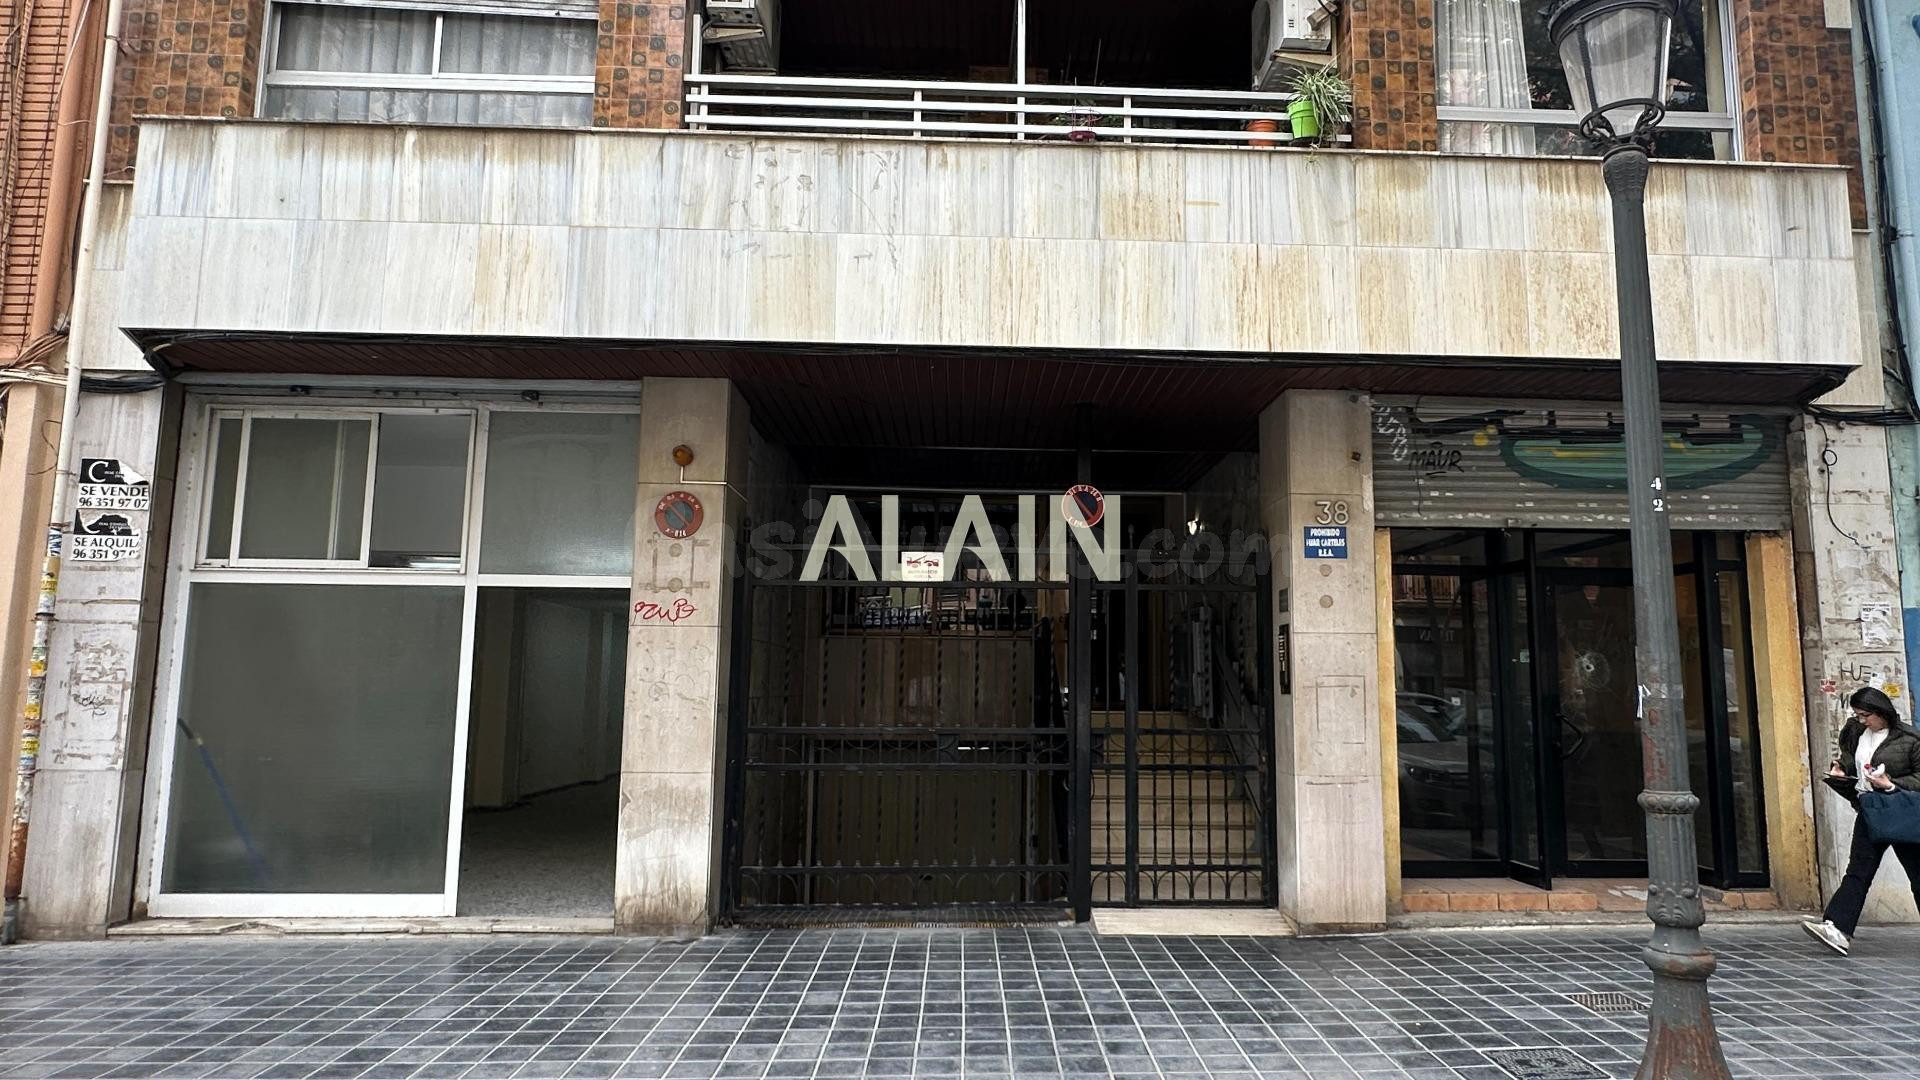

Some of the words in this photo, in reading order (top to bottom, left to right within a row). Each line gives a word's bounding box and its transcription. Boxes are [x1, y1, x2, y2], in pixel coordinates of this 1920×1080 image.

[80, 486, 97, 496] SE
[100, 486, 148, 497] VENDE
[79, 497, 93, 507] 96
[95, 498, 115, 507] 351
[118, 499, 131, 508] 97
[134, 499, 148, 508] 07
[1652, 498, 1664, 512] 2
[1316, 500, 1349, 525] 38
[74, 537, 89, 547] SE
[73, 549, 87, 559] 96
[89, 550, 108, 559] 351
